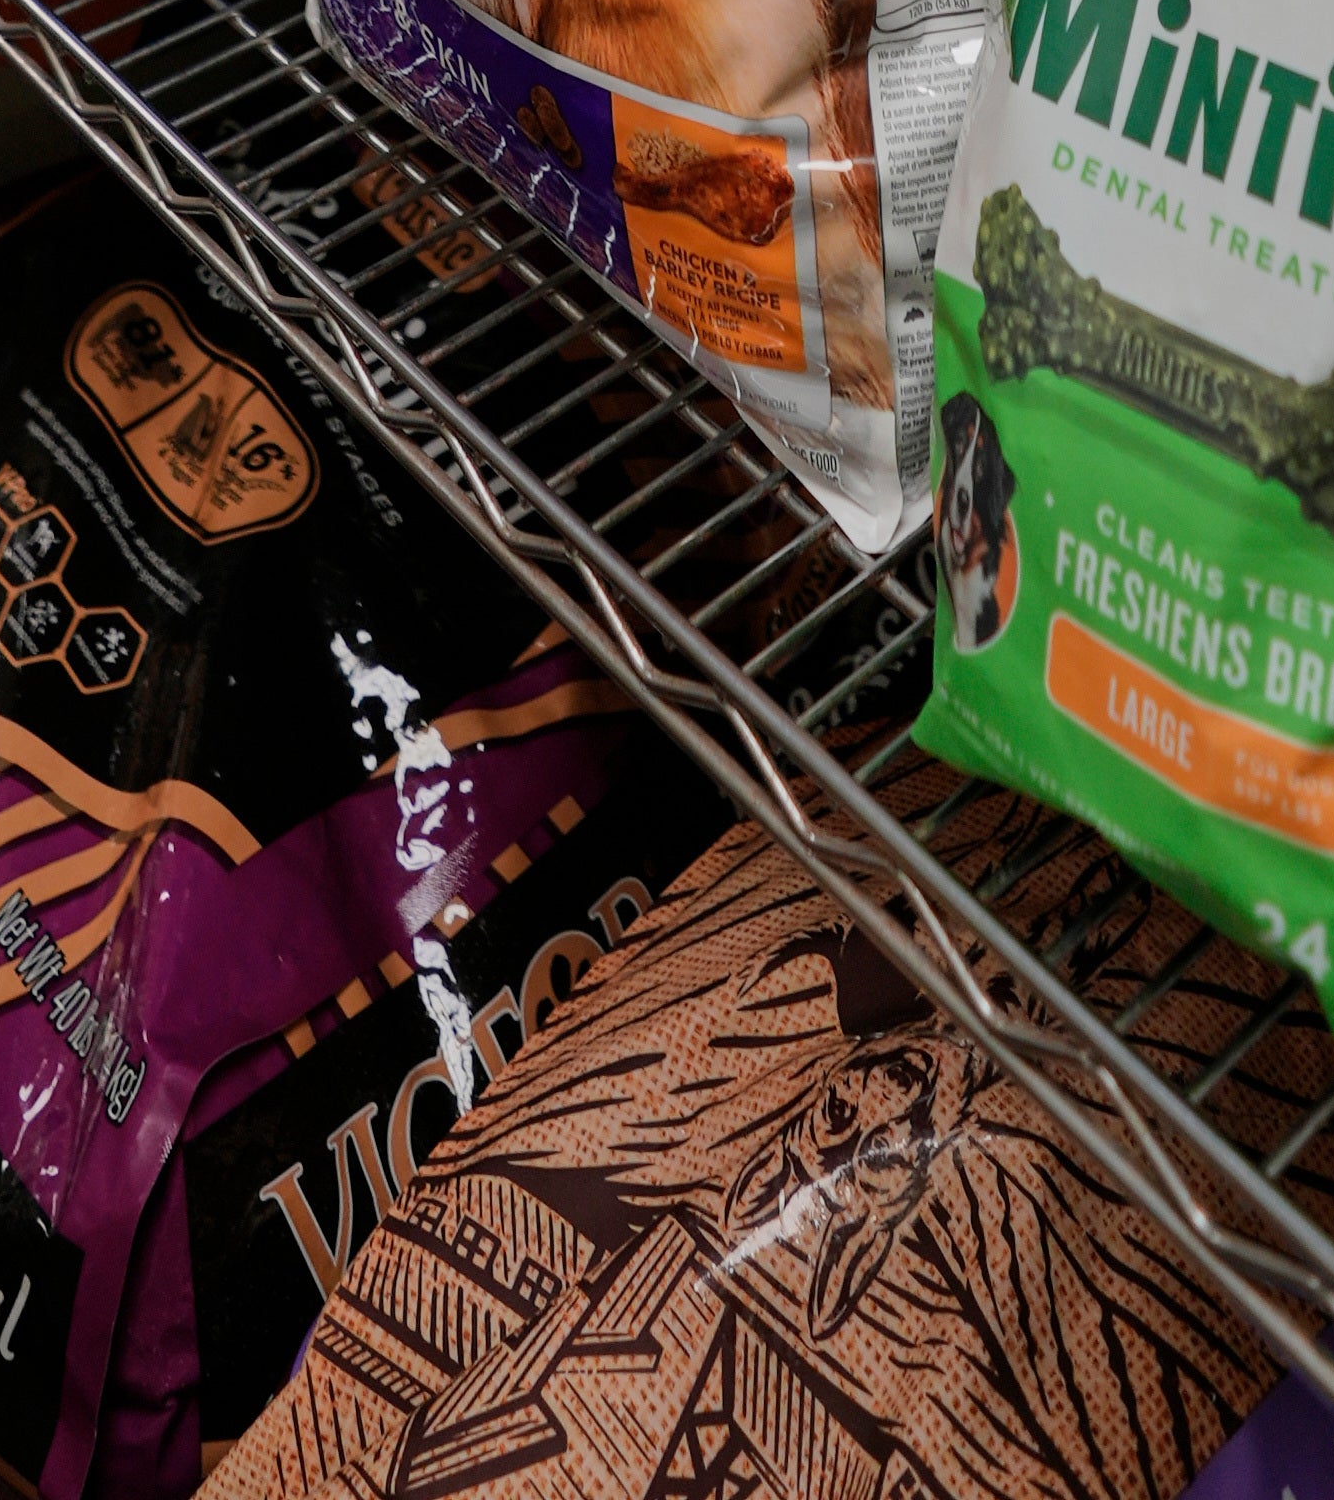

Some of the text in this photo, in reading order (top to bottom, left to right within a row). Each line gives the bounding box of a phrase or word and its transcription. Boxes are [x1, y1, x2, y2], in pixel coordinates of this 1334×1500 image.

[420, 23, 493, 105] SKIN
[878, 75, 903, 90] Adjust
[879, 88, 905, 103] Please
[926, 100, 947, 113] votre
[885, 132, 906, 146] votre
[887, 147, 916, 164] Ajustez
[889, 157, 932, 176] s'agit d'une
[907, 174, 936, 188] importa
[1050, 140, 1190, 236] DENTAL
[891, 202, 915, 216] Ajuste
[891, 213, 924, 228] corporal
[659, 239, 738, 280] CHICKEN
[644, 248, 781, 312] BARLEY RECIPE
[722, 303, 760, 324] POULET
[743, 341, 784, 362] CEBADA
[1114, 328, 1233, 416] MINTIES
[228, 423, 298, 483] 16%
[809, 450, 839, 474] FOOD
[325, 415, 405, 528] STAGES
[1094, 501, 1228, 598] CLEANS
[1052, 529, 1254, 692] FRESHENS
[1106, 675, 1194, 771] LARGE
[1234, 746, 1279, 786] FOR
[1253, 902, 1332, 984] 24
[16, 935, 67, 1004] Wt.
